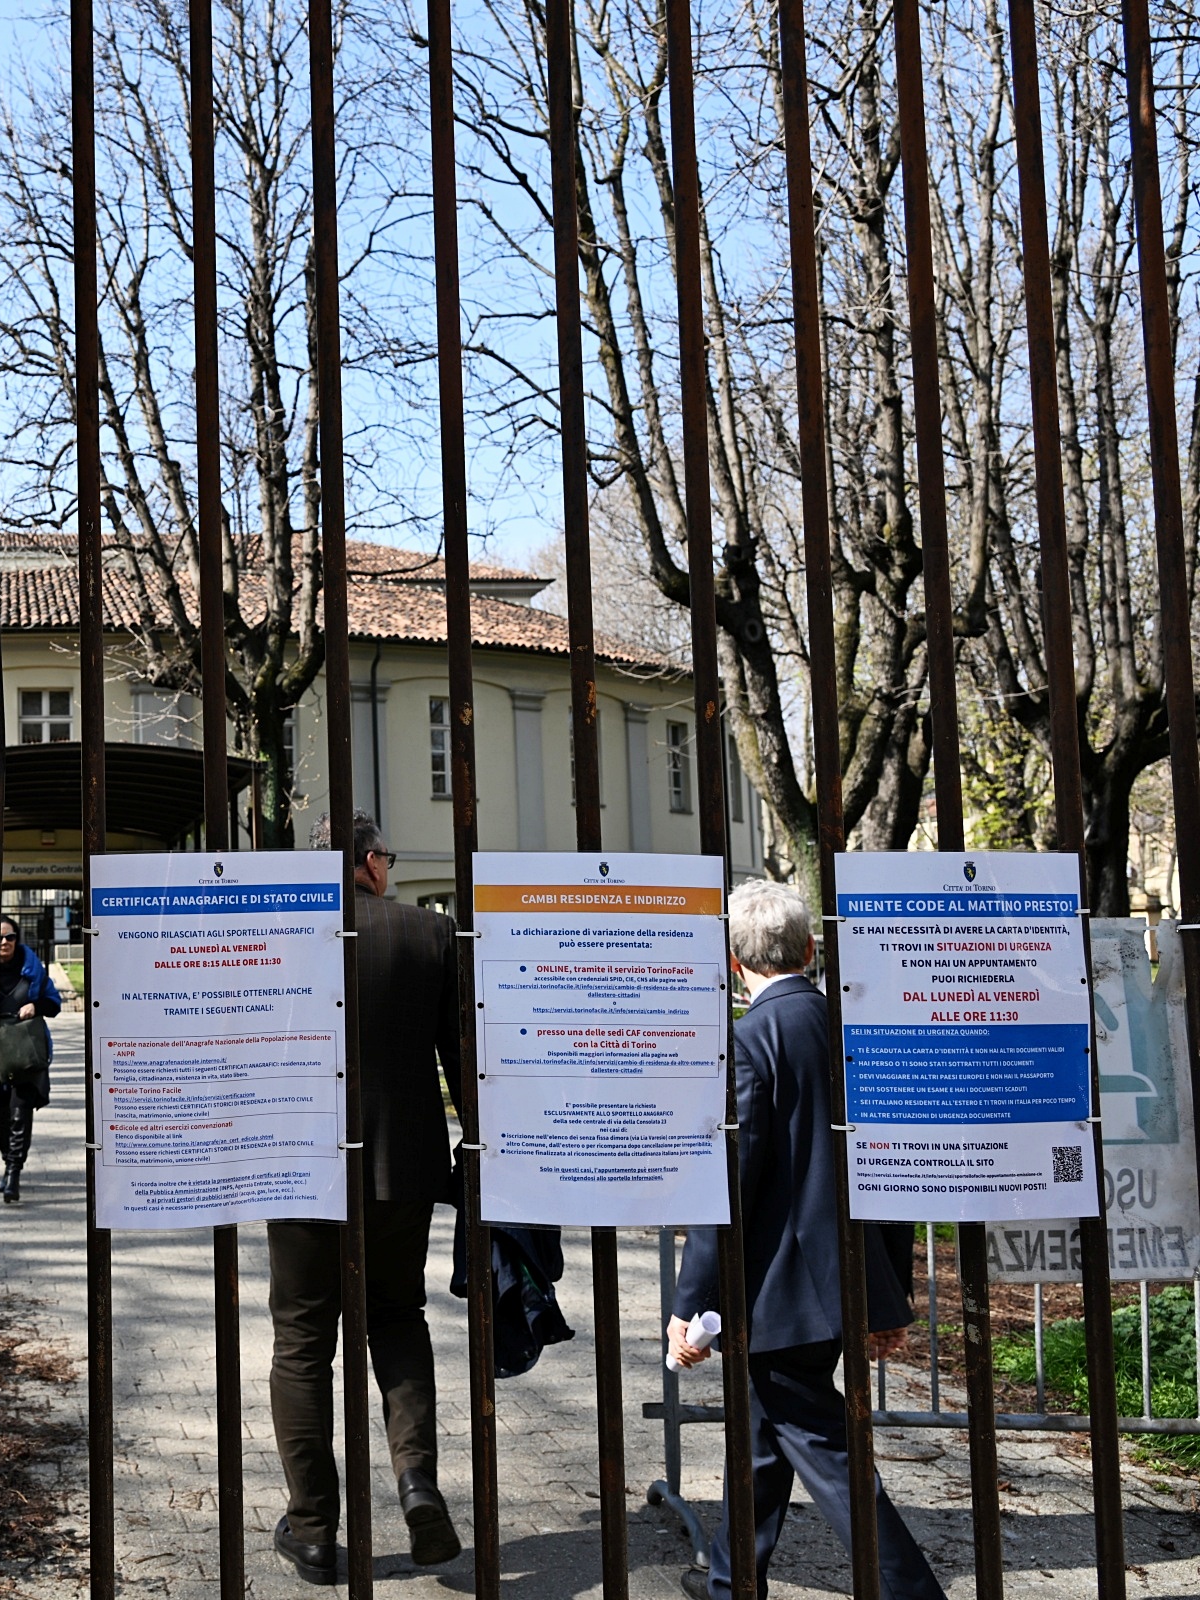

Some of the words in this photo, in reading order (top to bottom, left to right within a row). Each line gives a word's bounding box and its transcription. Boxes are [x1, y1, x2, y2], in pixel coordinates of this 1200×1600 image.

[10, 864, 49, 875] Anagrafe
[972, 883, 996, 892] TORINO
[101, 896, 170, 907] CERTIFICATI
[172, 894, 239, 906] ANAGRAFICI
[241, 894, 248, 905] E
[250, 894, 261, 904] DI
[263, 893, 298, 904] STATO
[299, 892, 334, 903] CIVILE
[521, 894, 558, 904] CAMBI
[559, 894, 623, 905] RESIDENZA
[624, 894, 632, 905] E
[633, 895, 687, 906] INDIRIZZO
[848, 900, 903, 912] NIENTE
[906, 899, 946, 912] CODE
[947, 900, 966, 912] AL
[967, 899, 1022, 913] MATTINO
[1024, 900, 1073, 913] PRESTO!
[117, 931, 159, 940] VENGONO
[160, 930, 206, 939] RILASCIATI
[206, 929, 225, 938] AGLI
[226, 928, 268, 938] SPORTELLI
[268, 926, 315, 936] ANAGRAFICI
[510, 928, 521, 936] La
[522, 927, 581, 936] dichiarazione
[582, 928, 591, 936] di
[591, 928, 636, 937] variazione
[636, 928, 657, 937] della
[657, 929, 694, 938] residenza
[852, 926, 865, 935] SE
[867, 926, 885, 935] HAI
[887, 923, 942, 935] NECESSITÀ
[943, 926, 953, 935] DI
[954, 925, 984, 935] AVERE
[984, 926, 996, 935] LA
[996, 925, 1023, 935] CARTA
[1023, 924, 1071, 936] D'IDENTITÀ,
[170, 946, 188, 954] DAL
[188, 943, 220, 954] LUNEDÌ
[220, 945, 232, 953] AL
[232, 941, 267, 953] VENERDÌ
[558, 938, 576, 949] può
[605, 941, 653, 950] presentata:
[154, 960, 182, 969] DALLE
[182, 960, 201, 969] ORE
[202, 959, 220, 968] 8:15
[221, 958, 241, 967] ALLE
[242, 958, 259, 967] ORE
[260, 957, 282, 966] 11:30
[536, 965, 573, 975] ONLINE,
[573, 965, 606, 974] tramite
[607, 965, 613, 974] il
[614, 965, 646, 974] servizio
[646, 966, 694, 975] TorinoFacile
[931, 974, 956, 984] PUOI
[957, 974, 1016, 984] RICHIEDERLA
[903, 991, 928, 1002] DAL
[930, 988, 975, 1002] LUNEDÌ
[977, 991, 992, 1002] AL
[994, 988, 1040, 1002] VENERDÌ
[930, 1011, 961, 1022] ALLE
[962, 1011, 987, 1022] ORE
[989, 1011, 1019, 1022] 11:30
